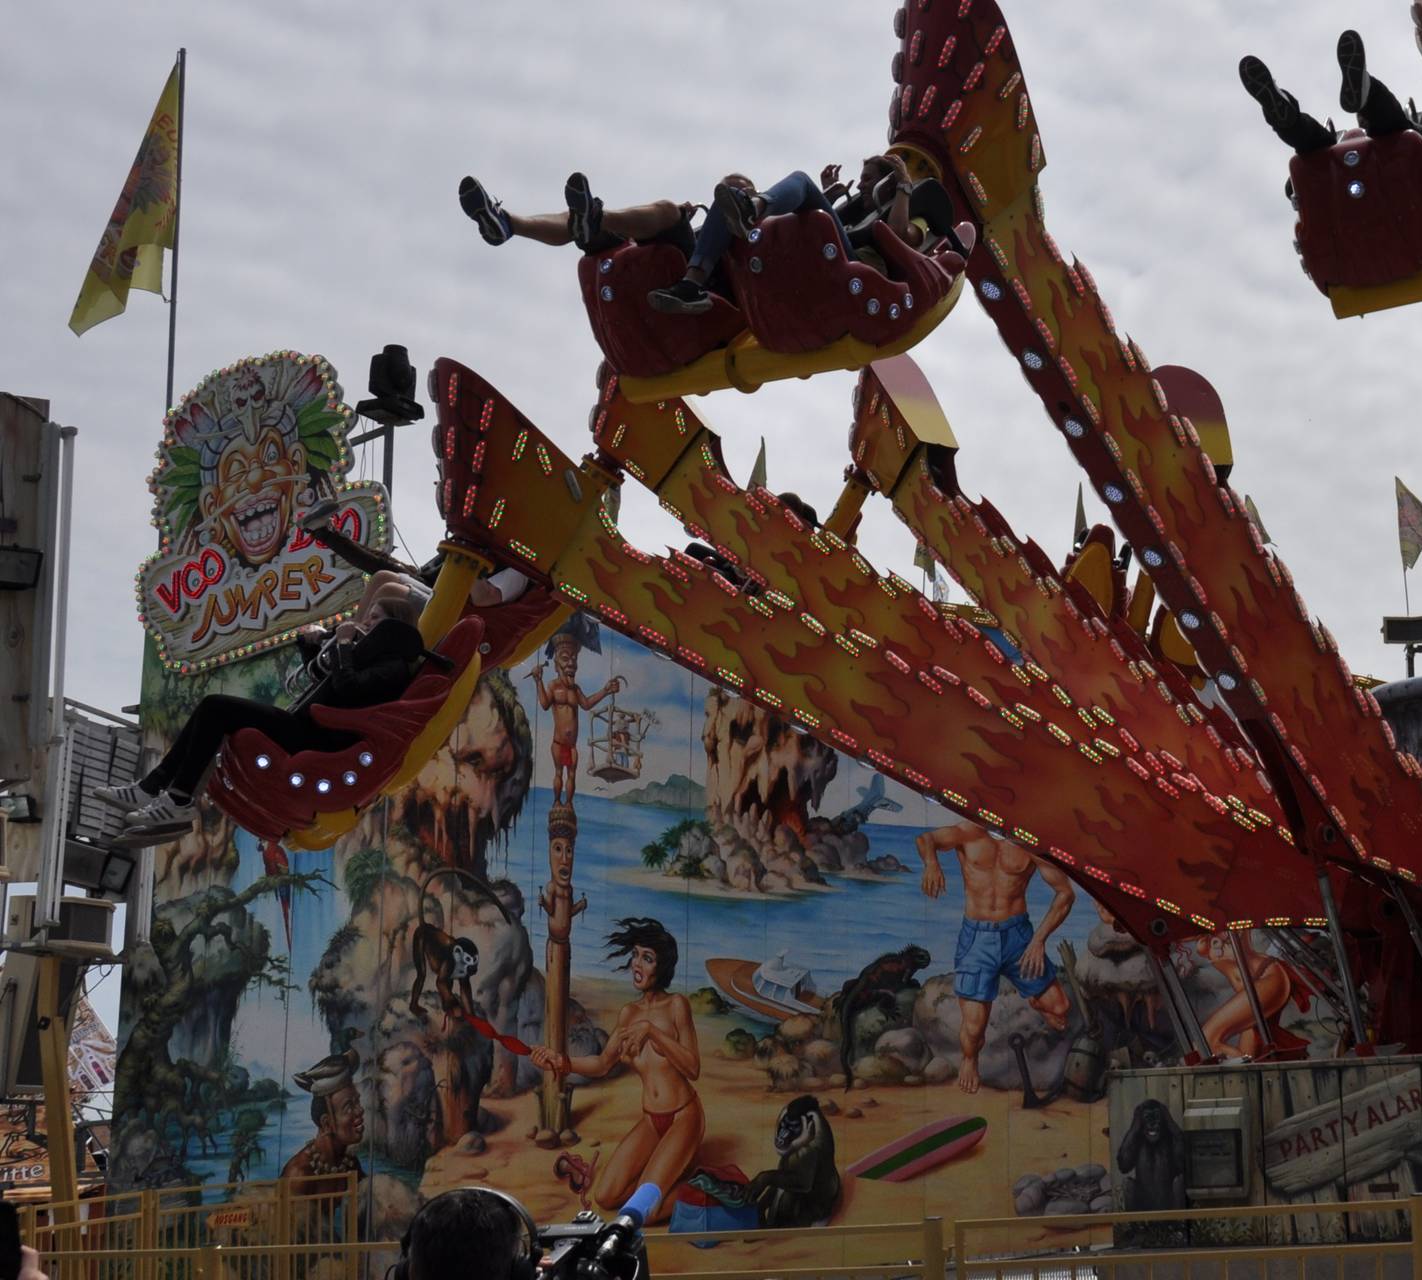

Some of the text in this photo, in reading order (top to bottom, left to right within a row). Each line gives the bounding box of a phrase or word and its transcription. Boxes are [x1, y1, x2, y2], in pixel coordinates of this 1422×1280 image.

[155, 548, 225, 614] VOO
[191, 555, 336, 643] JUMPER
[1279, 1110, 1358, 1159] PARTY
